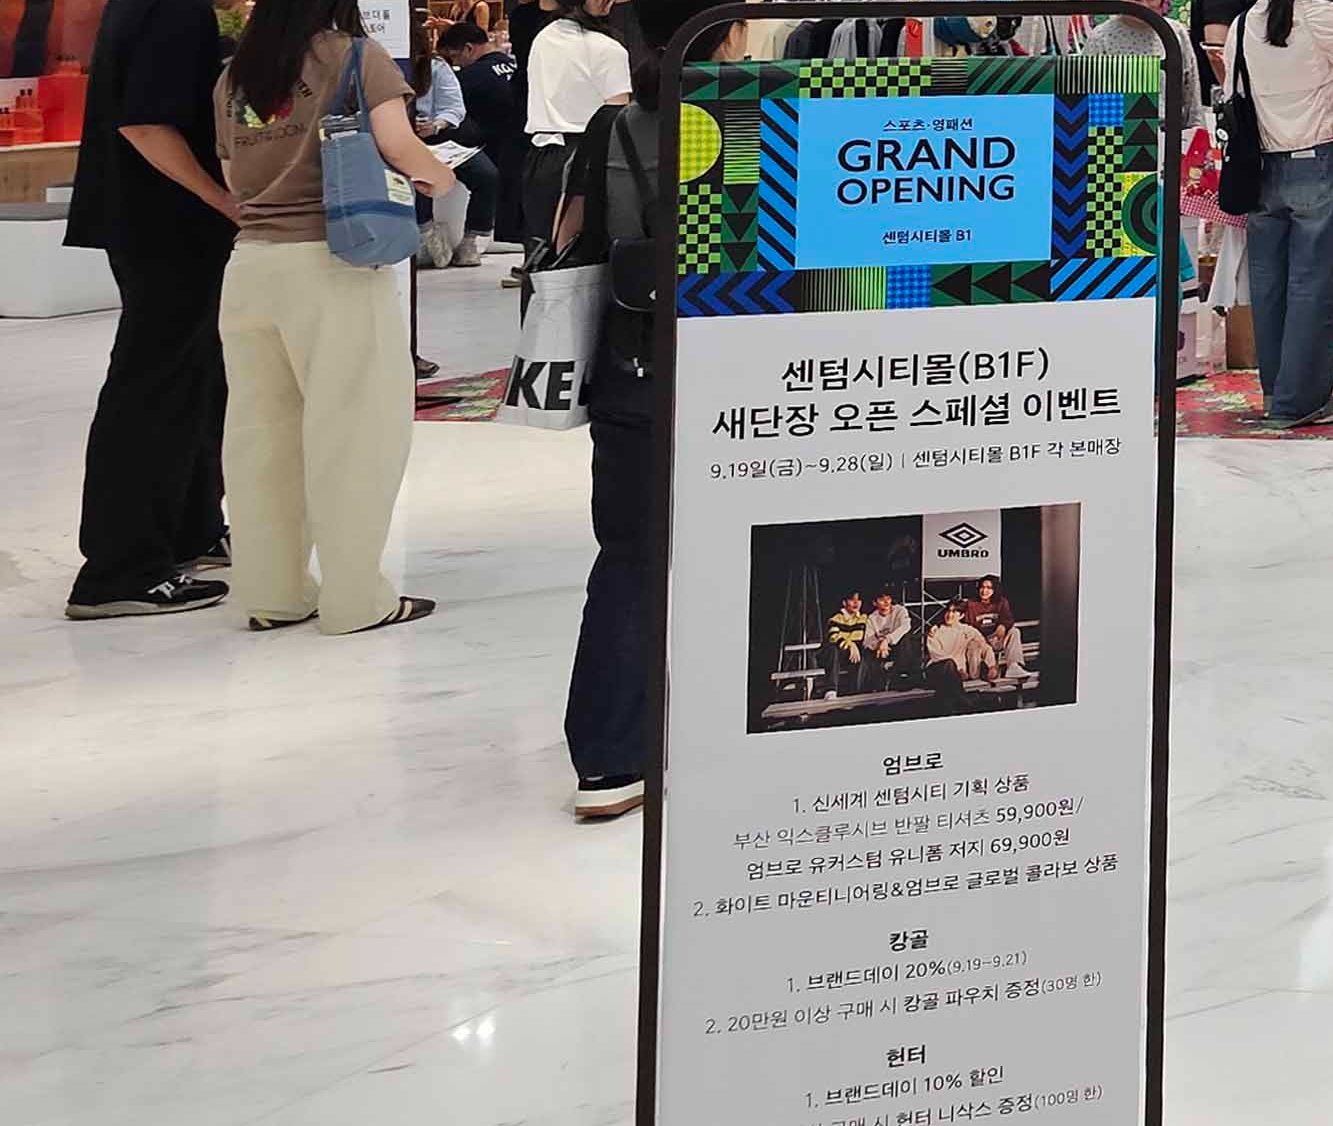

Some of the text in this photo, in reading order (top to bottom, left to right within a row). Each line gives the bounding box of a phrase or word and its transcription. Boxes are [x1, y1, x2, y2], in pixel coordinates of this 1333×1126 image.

[882, 117, 973, 132] 스포츠·영패션
[837, 136, 1016, 173] GRAND
[836, 175, 1016, 205] OPENING
[882, 229, 971, 245] 센텀시티몰 B1
[505, 355, 590, 411] KE
[781, 347, 1052, 395] 센텀시티몰(B1F)
[712, 387, 1121, 440] 새단장 오픈 스페셜 이벤트
[711, 437, 1122, 479] 9.19일(금)~9.28(일) 센텀시티몰 B1F 각 본매장
[938, 548, 989, 559] UMBRO
[883, 753, 944, 776] 엄브로
[794, 774, 1029, 813] 1. 신세계 센텀시티 기획 상품
[734, 796, 1083, 850] 부산 익스클루시브 반팔 티셔츠 59,900원/
[747, 828, 1069, 881] 엄브로 유커스텀 유니폼 저지 69,900원
[694, 854, 1118, 917] 2. 화이트 마운티니어링&엄브로 글로벌 콜라보 상품
[889, 930, 929, 952] 캉골
[787, 978, 800, 992] 1.
[807, 964, 898, 990] 브랜드데이
[705, 1019, 721, 1034] 2.
[728, 1010, 787, 1031] 20만원
[794, 1005, 832, 1025] 이상
[837, 1000, 873, 1020] 구매
[880, 997, 896, 1014] 시
[904, 992, 939, 1012] 캉골
[945, 984, 998, 1006] 파우치
[886, 1044, 925, 1068] 헌터
[806, 1066, 1003, 1108] 1. 브랜드데이 10% 할인
[939, 1101, 992, 1122] 니삭스
